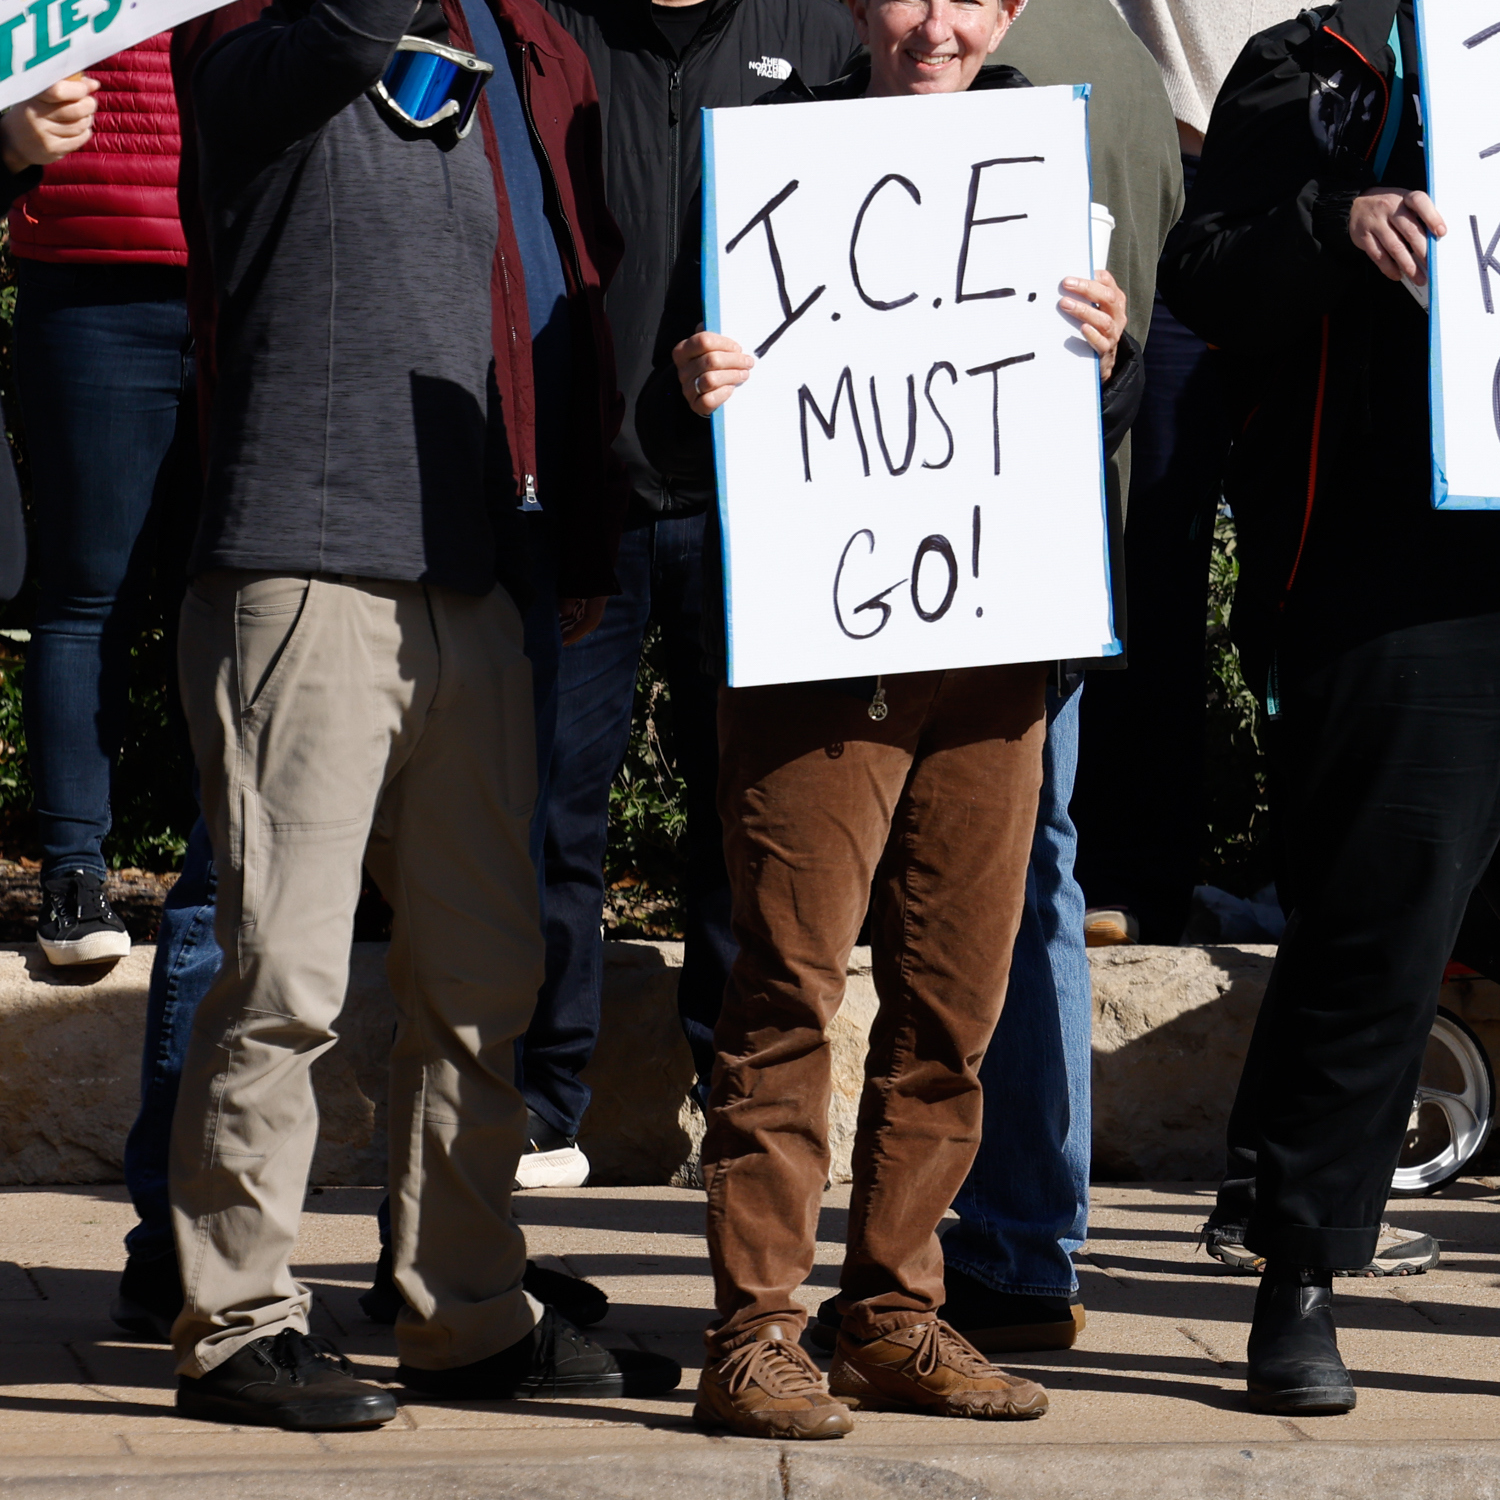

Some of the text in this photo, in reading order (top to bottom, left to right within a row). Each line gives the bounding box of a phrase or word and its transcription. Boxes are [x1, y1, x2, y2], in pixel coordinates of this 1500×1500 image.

[748, 61, 778, 72] NORTH
[757, 69, 778, 79] FACE
[761, 55, 778, 66] THE
[726, 156, 1045, 358] I.C.E.
[798, 352, 1035, 482] MUST
[834, 505, 984, 640] GO!
